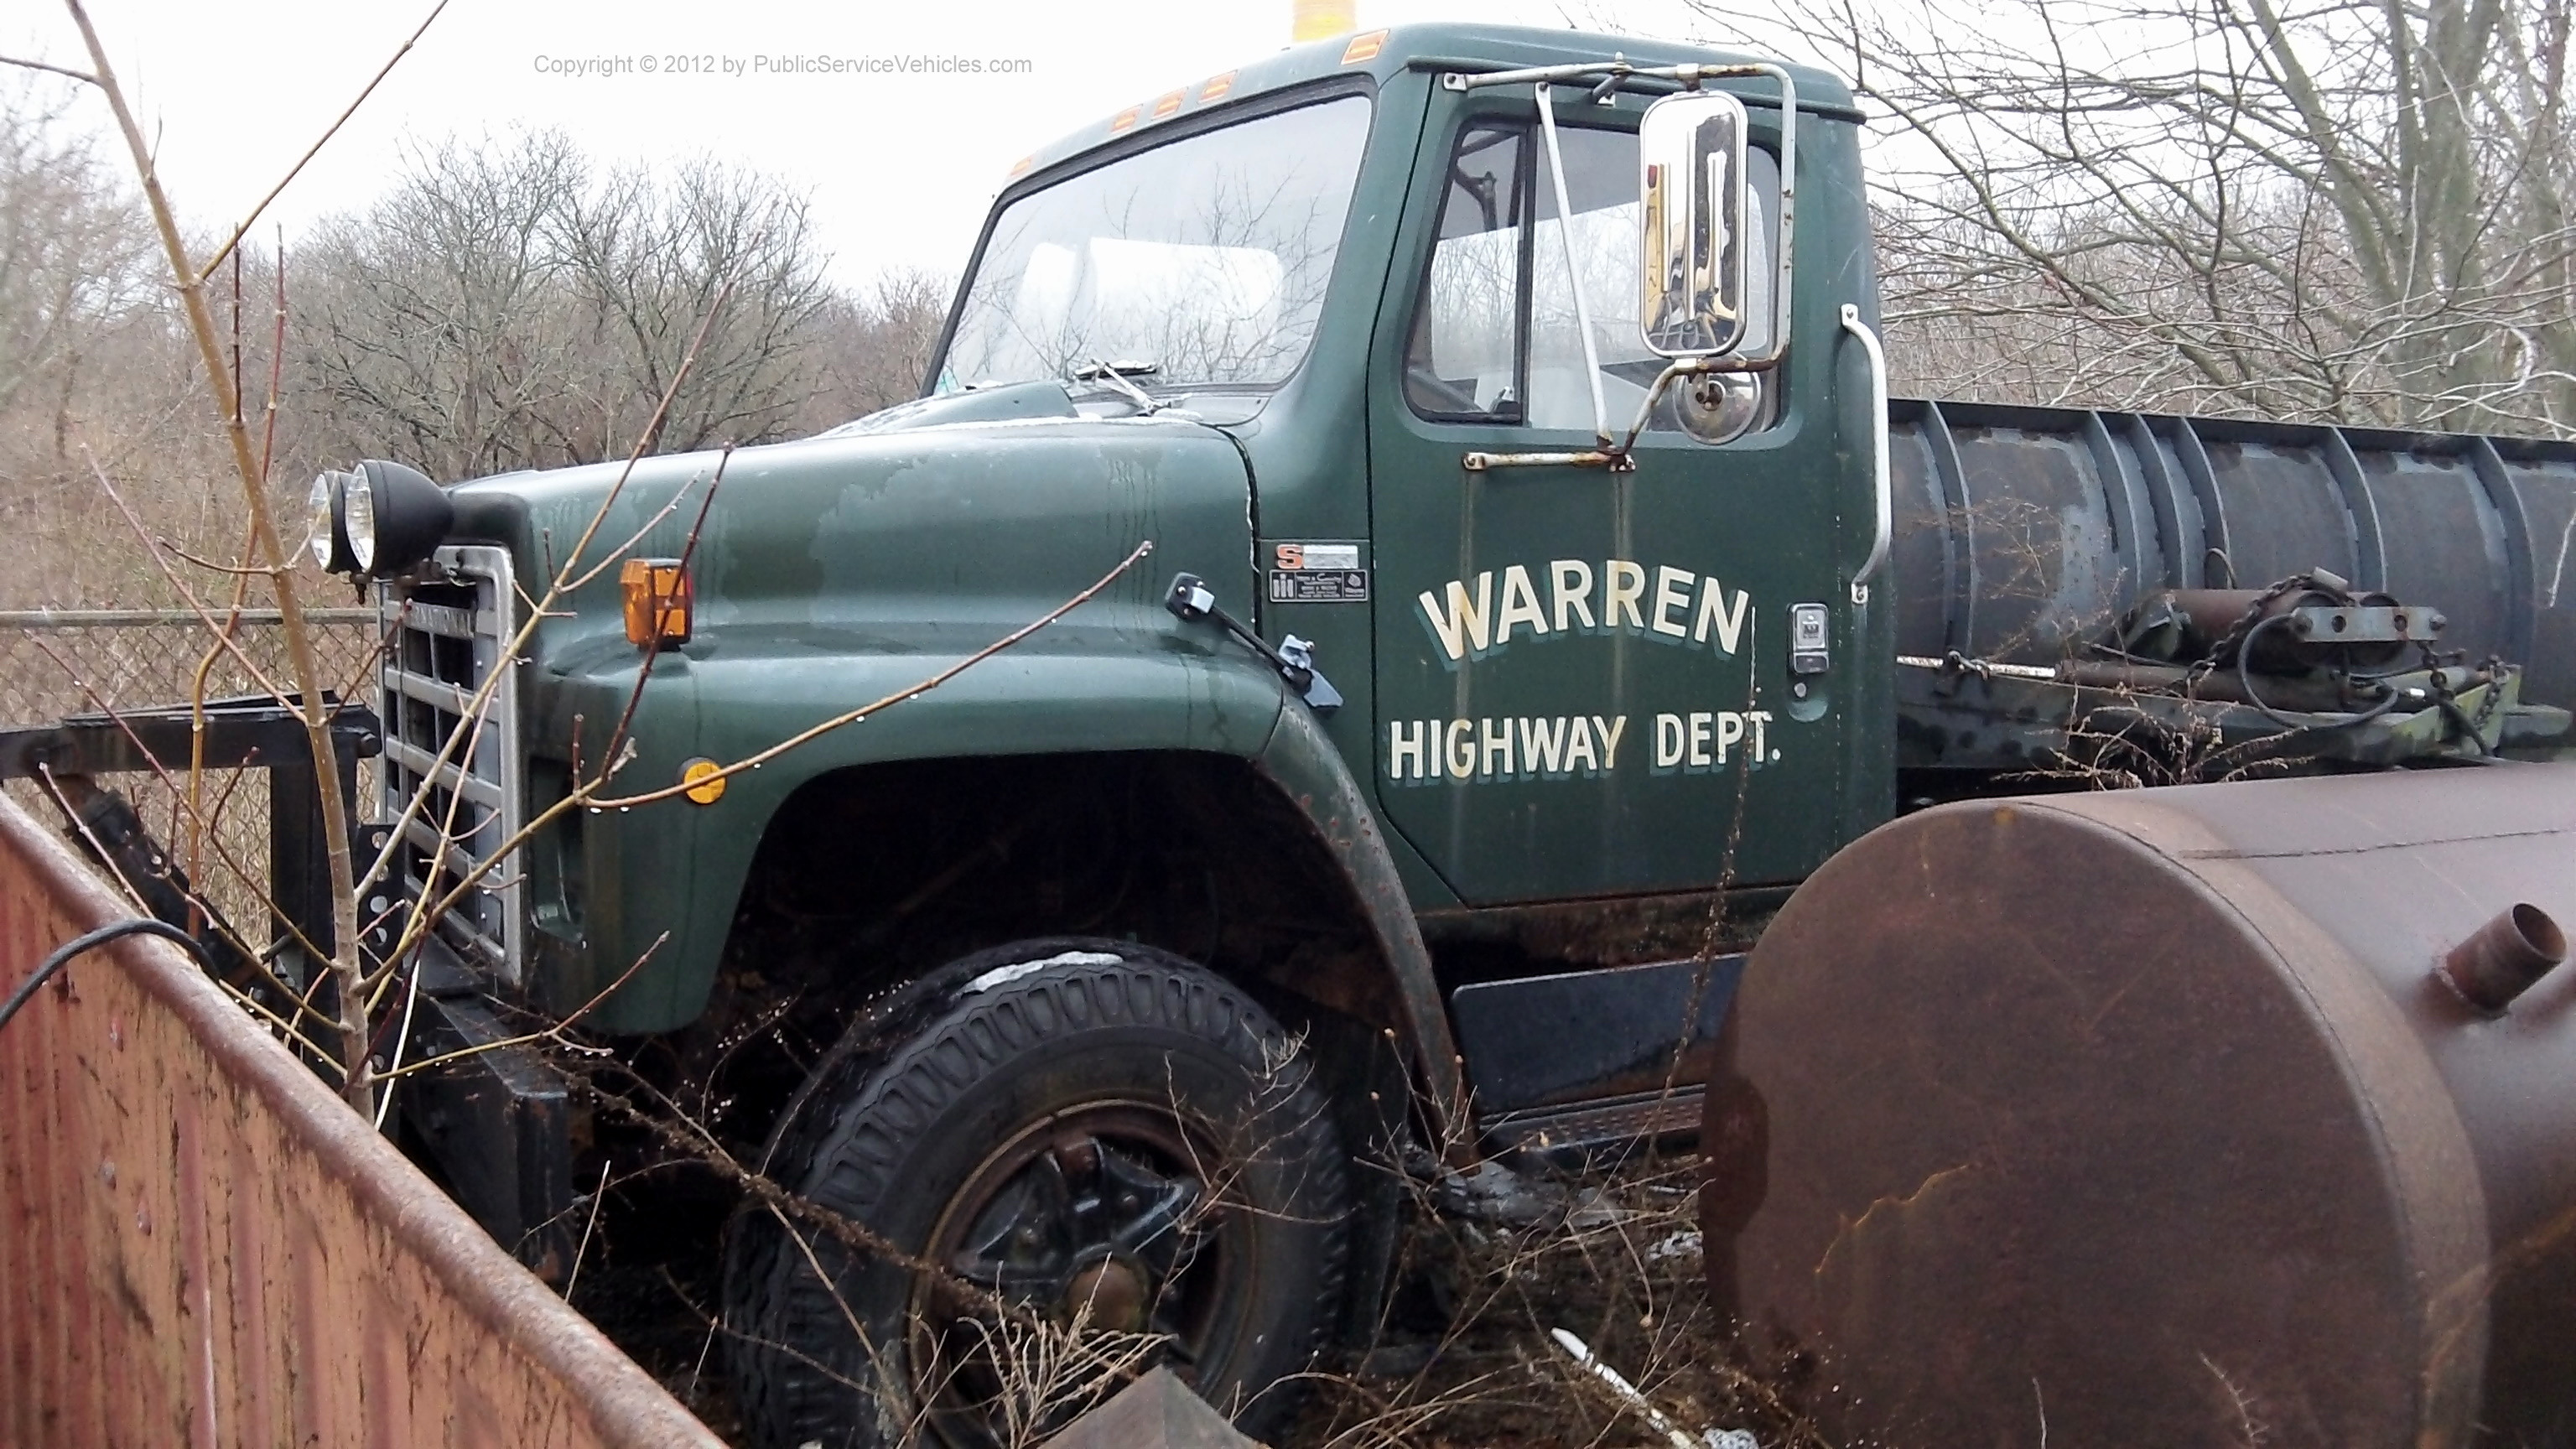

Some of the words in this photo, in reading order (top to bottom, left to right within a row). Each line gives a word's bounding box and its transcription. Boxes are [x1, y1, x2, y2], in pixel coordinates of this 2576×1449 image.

[1276, 543, 1303, 569] S
[1417, 559, 1749, 662] WARREN
[1390, 715, 1627, 780] HIGHWAY
[1656, 711, 1781, 767] DEPT.
